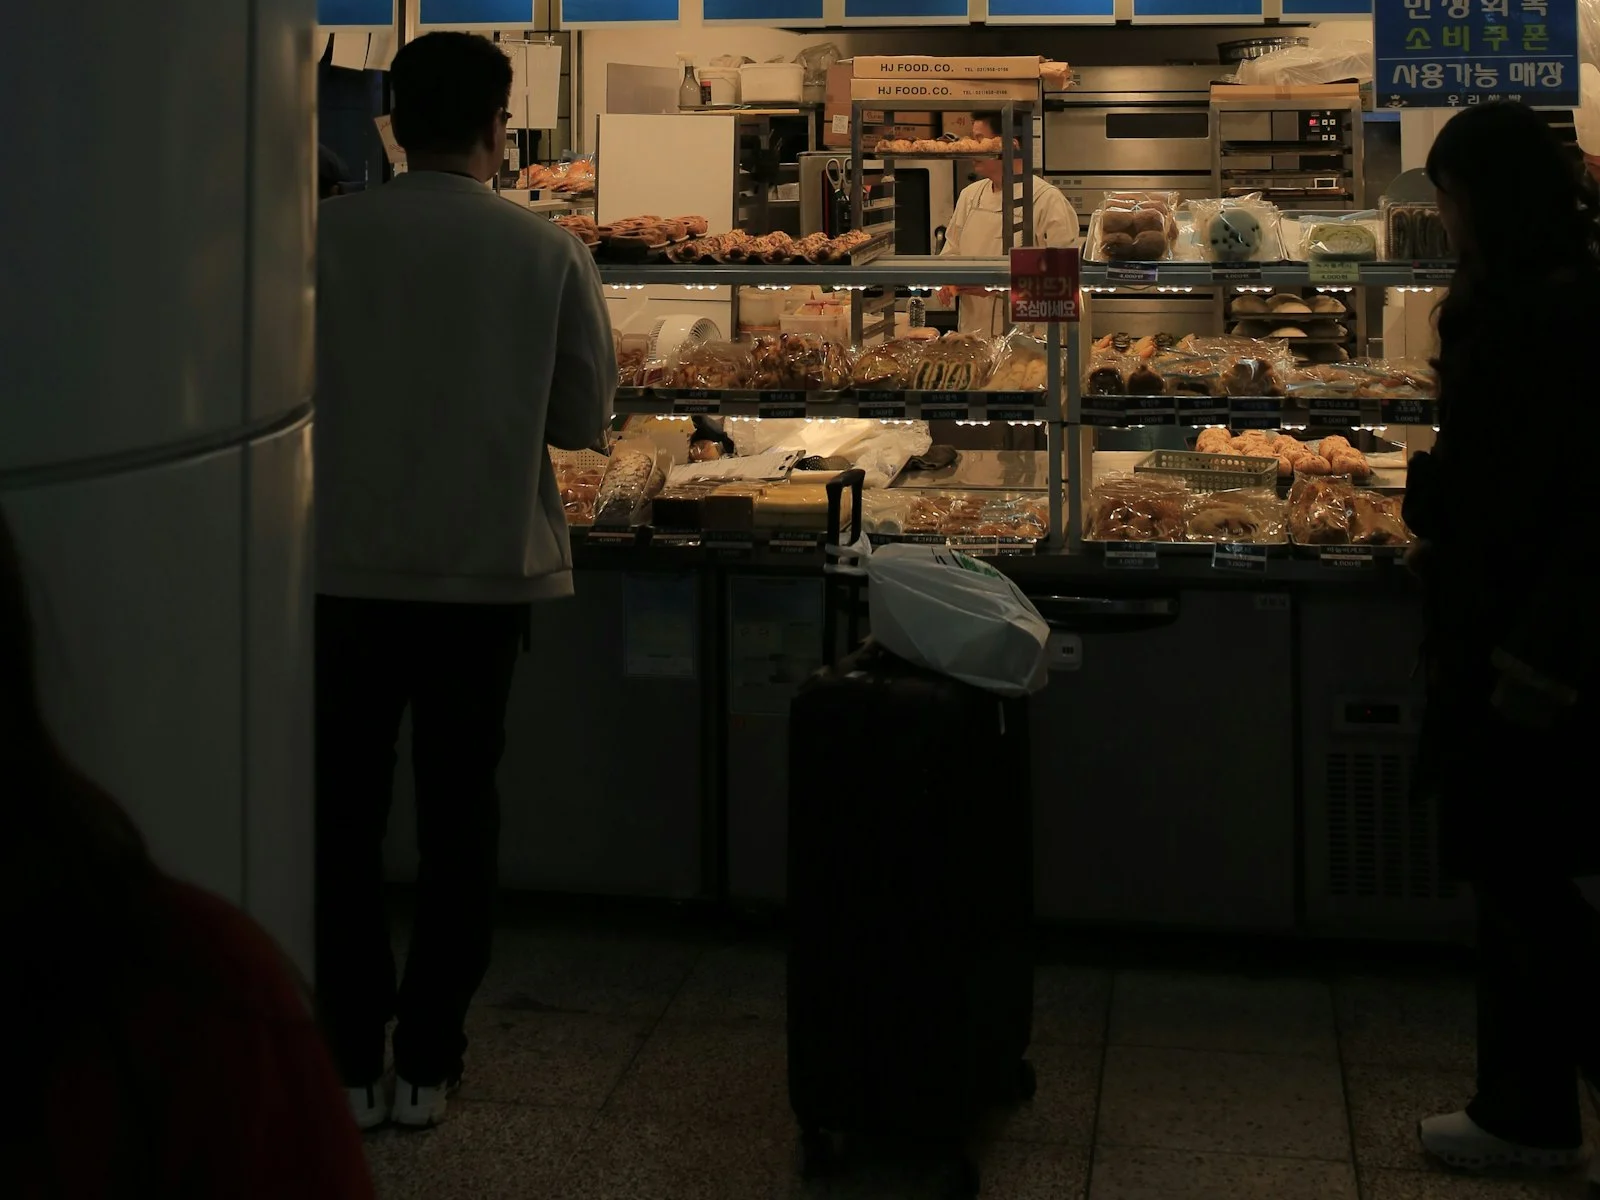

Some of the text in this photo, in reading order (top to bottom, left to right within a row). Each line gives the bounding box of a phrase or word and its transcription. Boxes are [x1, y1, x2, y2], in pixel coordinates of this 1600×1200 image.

[1404, 23, 1550, 52] 소비쿠폰
[880, 63, 894, 72] HJ
[1392, 61, 1565, 90] 사용가능 매장
[878, 86, 892, 95] HJ
[1015, 299, 1076, 318] 조심하세요
